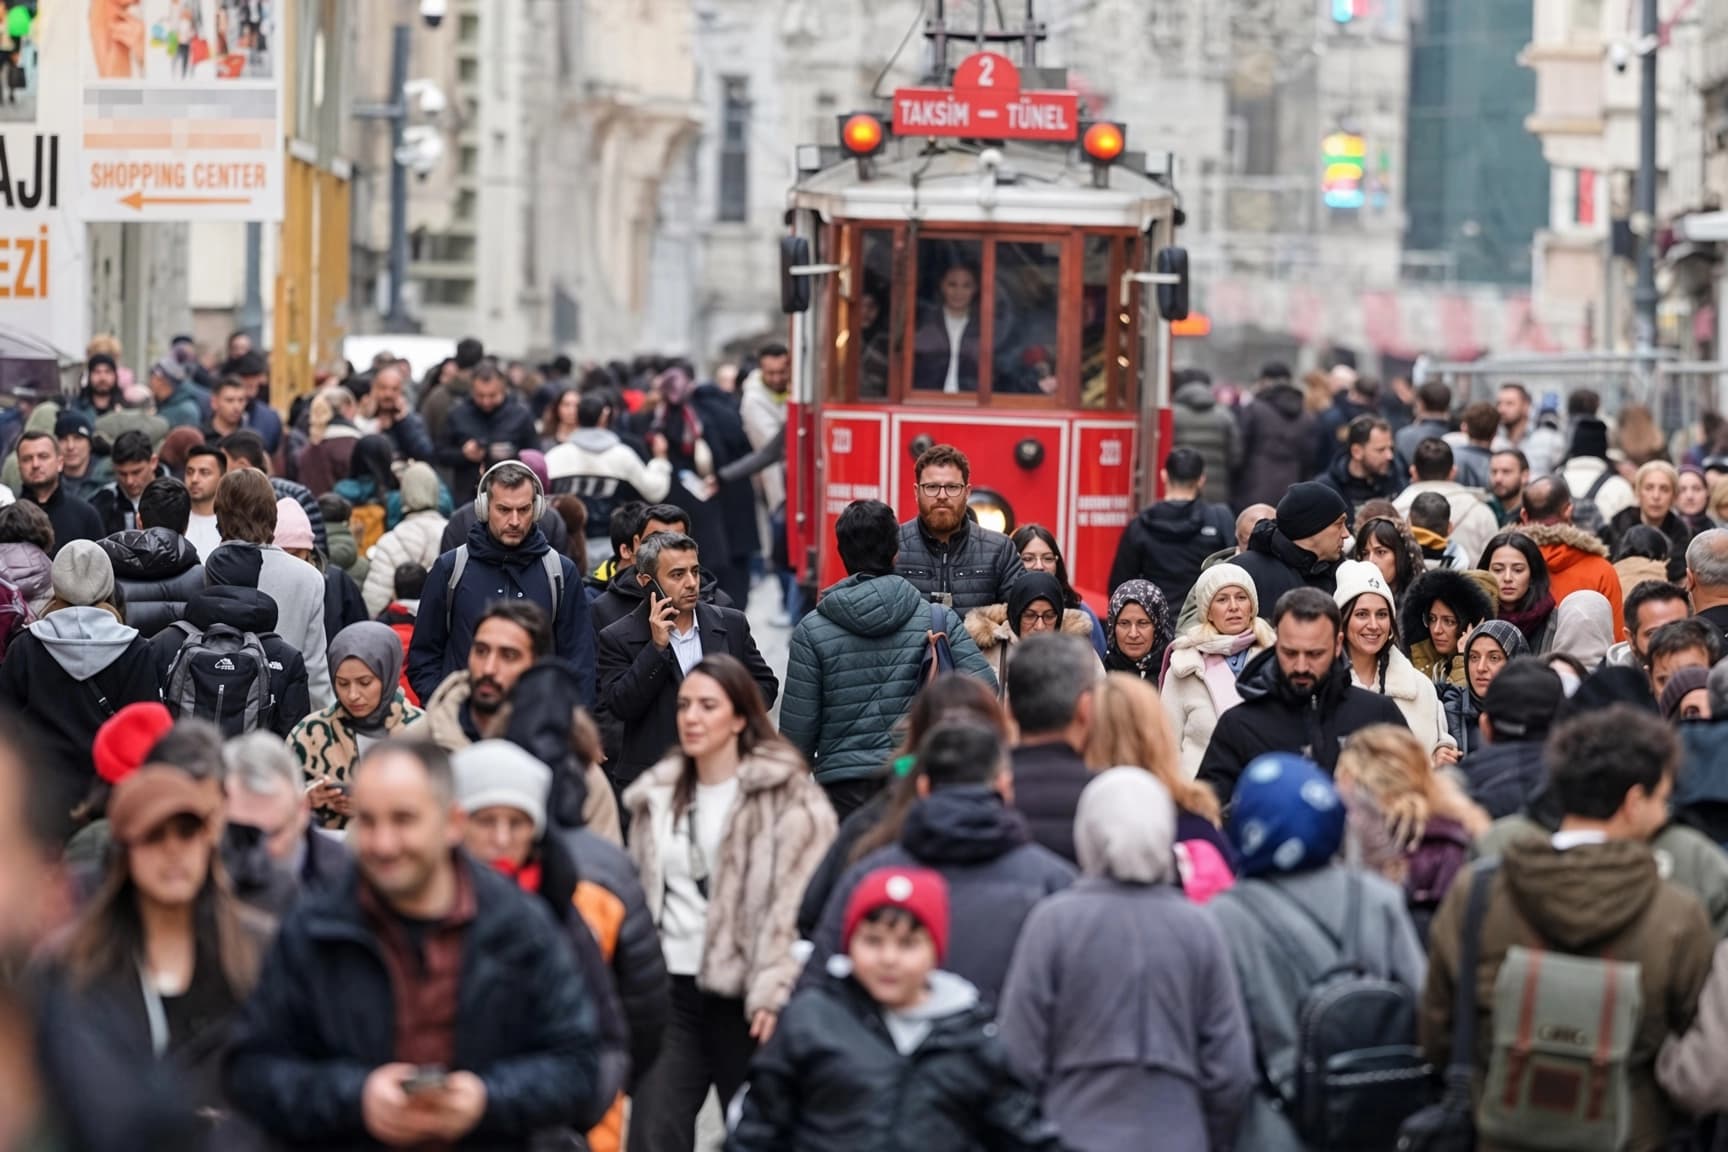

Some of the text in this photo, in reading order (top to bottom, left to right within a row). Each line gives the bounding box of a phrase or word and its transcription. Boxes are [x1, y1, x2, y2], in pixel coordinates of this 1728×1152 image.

[978, 56, 994, 87] 2
[901, 95, 970, 127] TAKSİM
[1006, 97, 1068, 130] TÜNEL
[91, 162, 266, 189] SHOPPING CENTER
